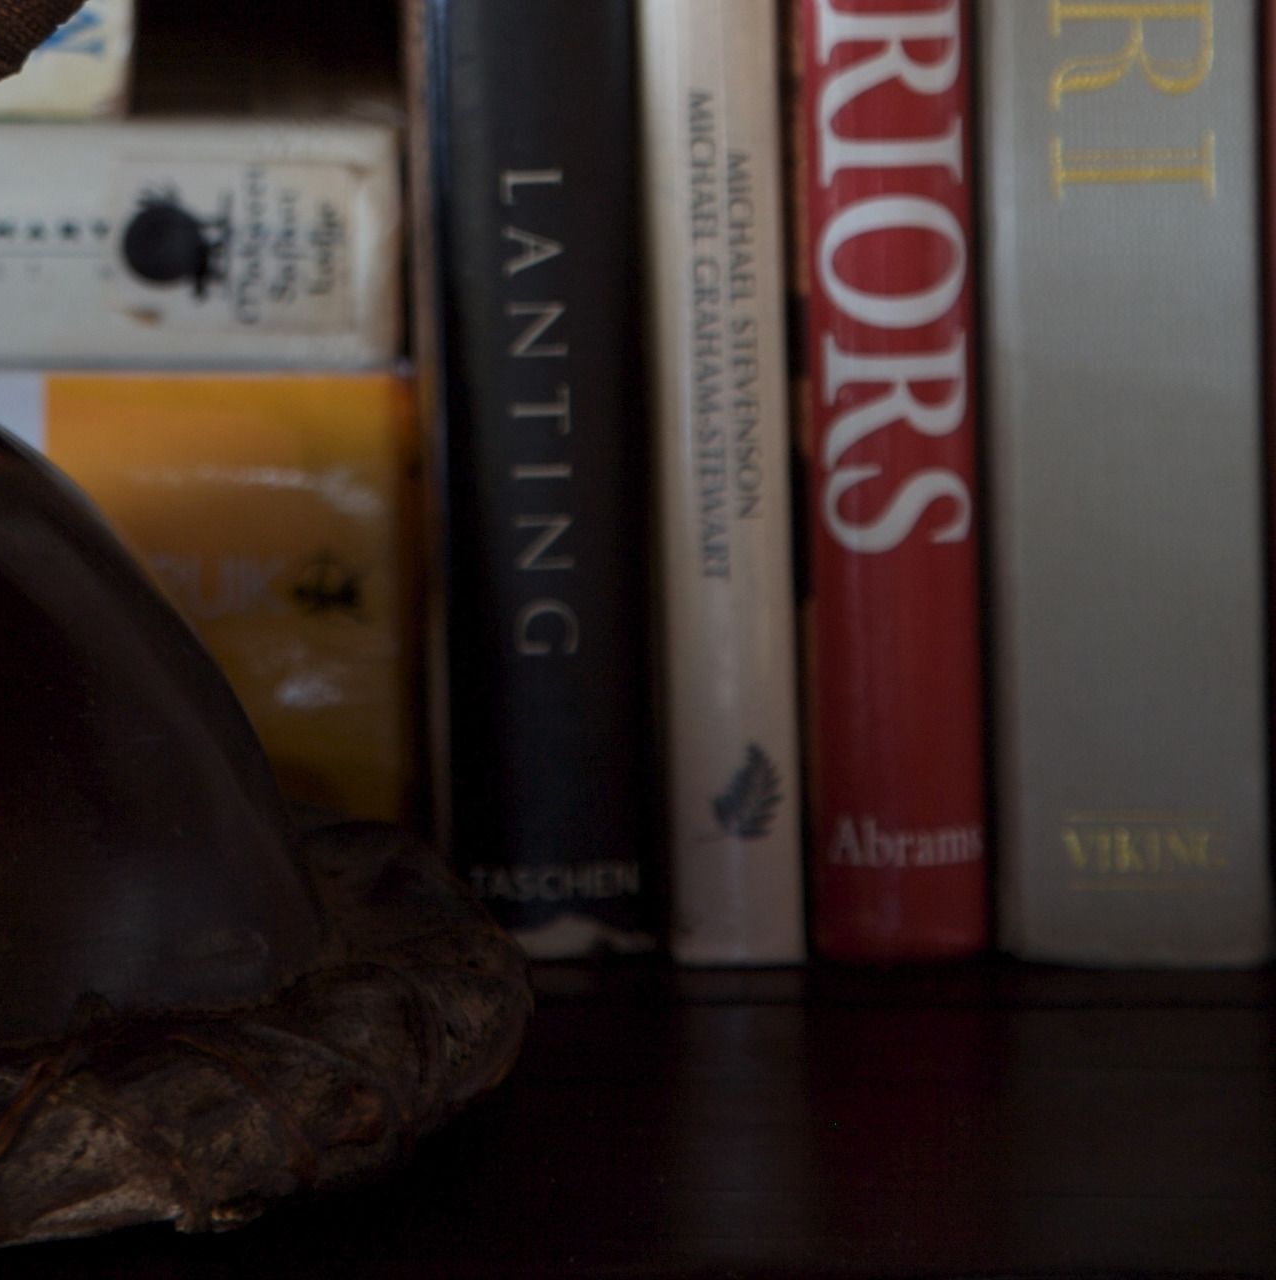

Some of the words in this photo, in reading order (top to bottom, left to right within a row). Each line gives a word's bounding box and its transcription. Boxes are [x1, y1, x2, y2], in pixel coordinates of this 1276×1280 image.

[688, 88, 718, 244] MICHAEL
[727, 149, 757, 308] MICHAEL
[500, 167, 579, 657] LANTING
[690, 253, 731, 581] GRAHAM-STEWART
[731, 312, 762, 520] STEVENSON
[468, 860, 641, 902] TASCHEN
[1060, 825, 1230, 874] VIKING
